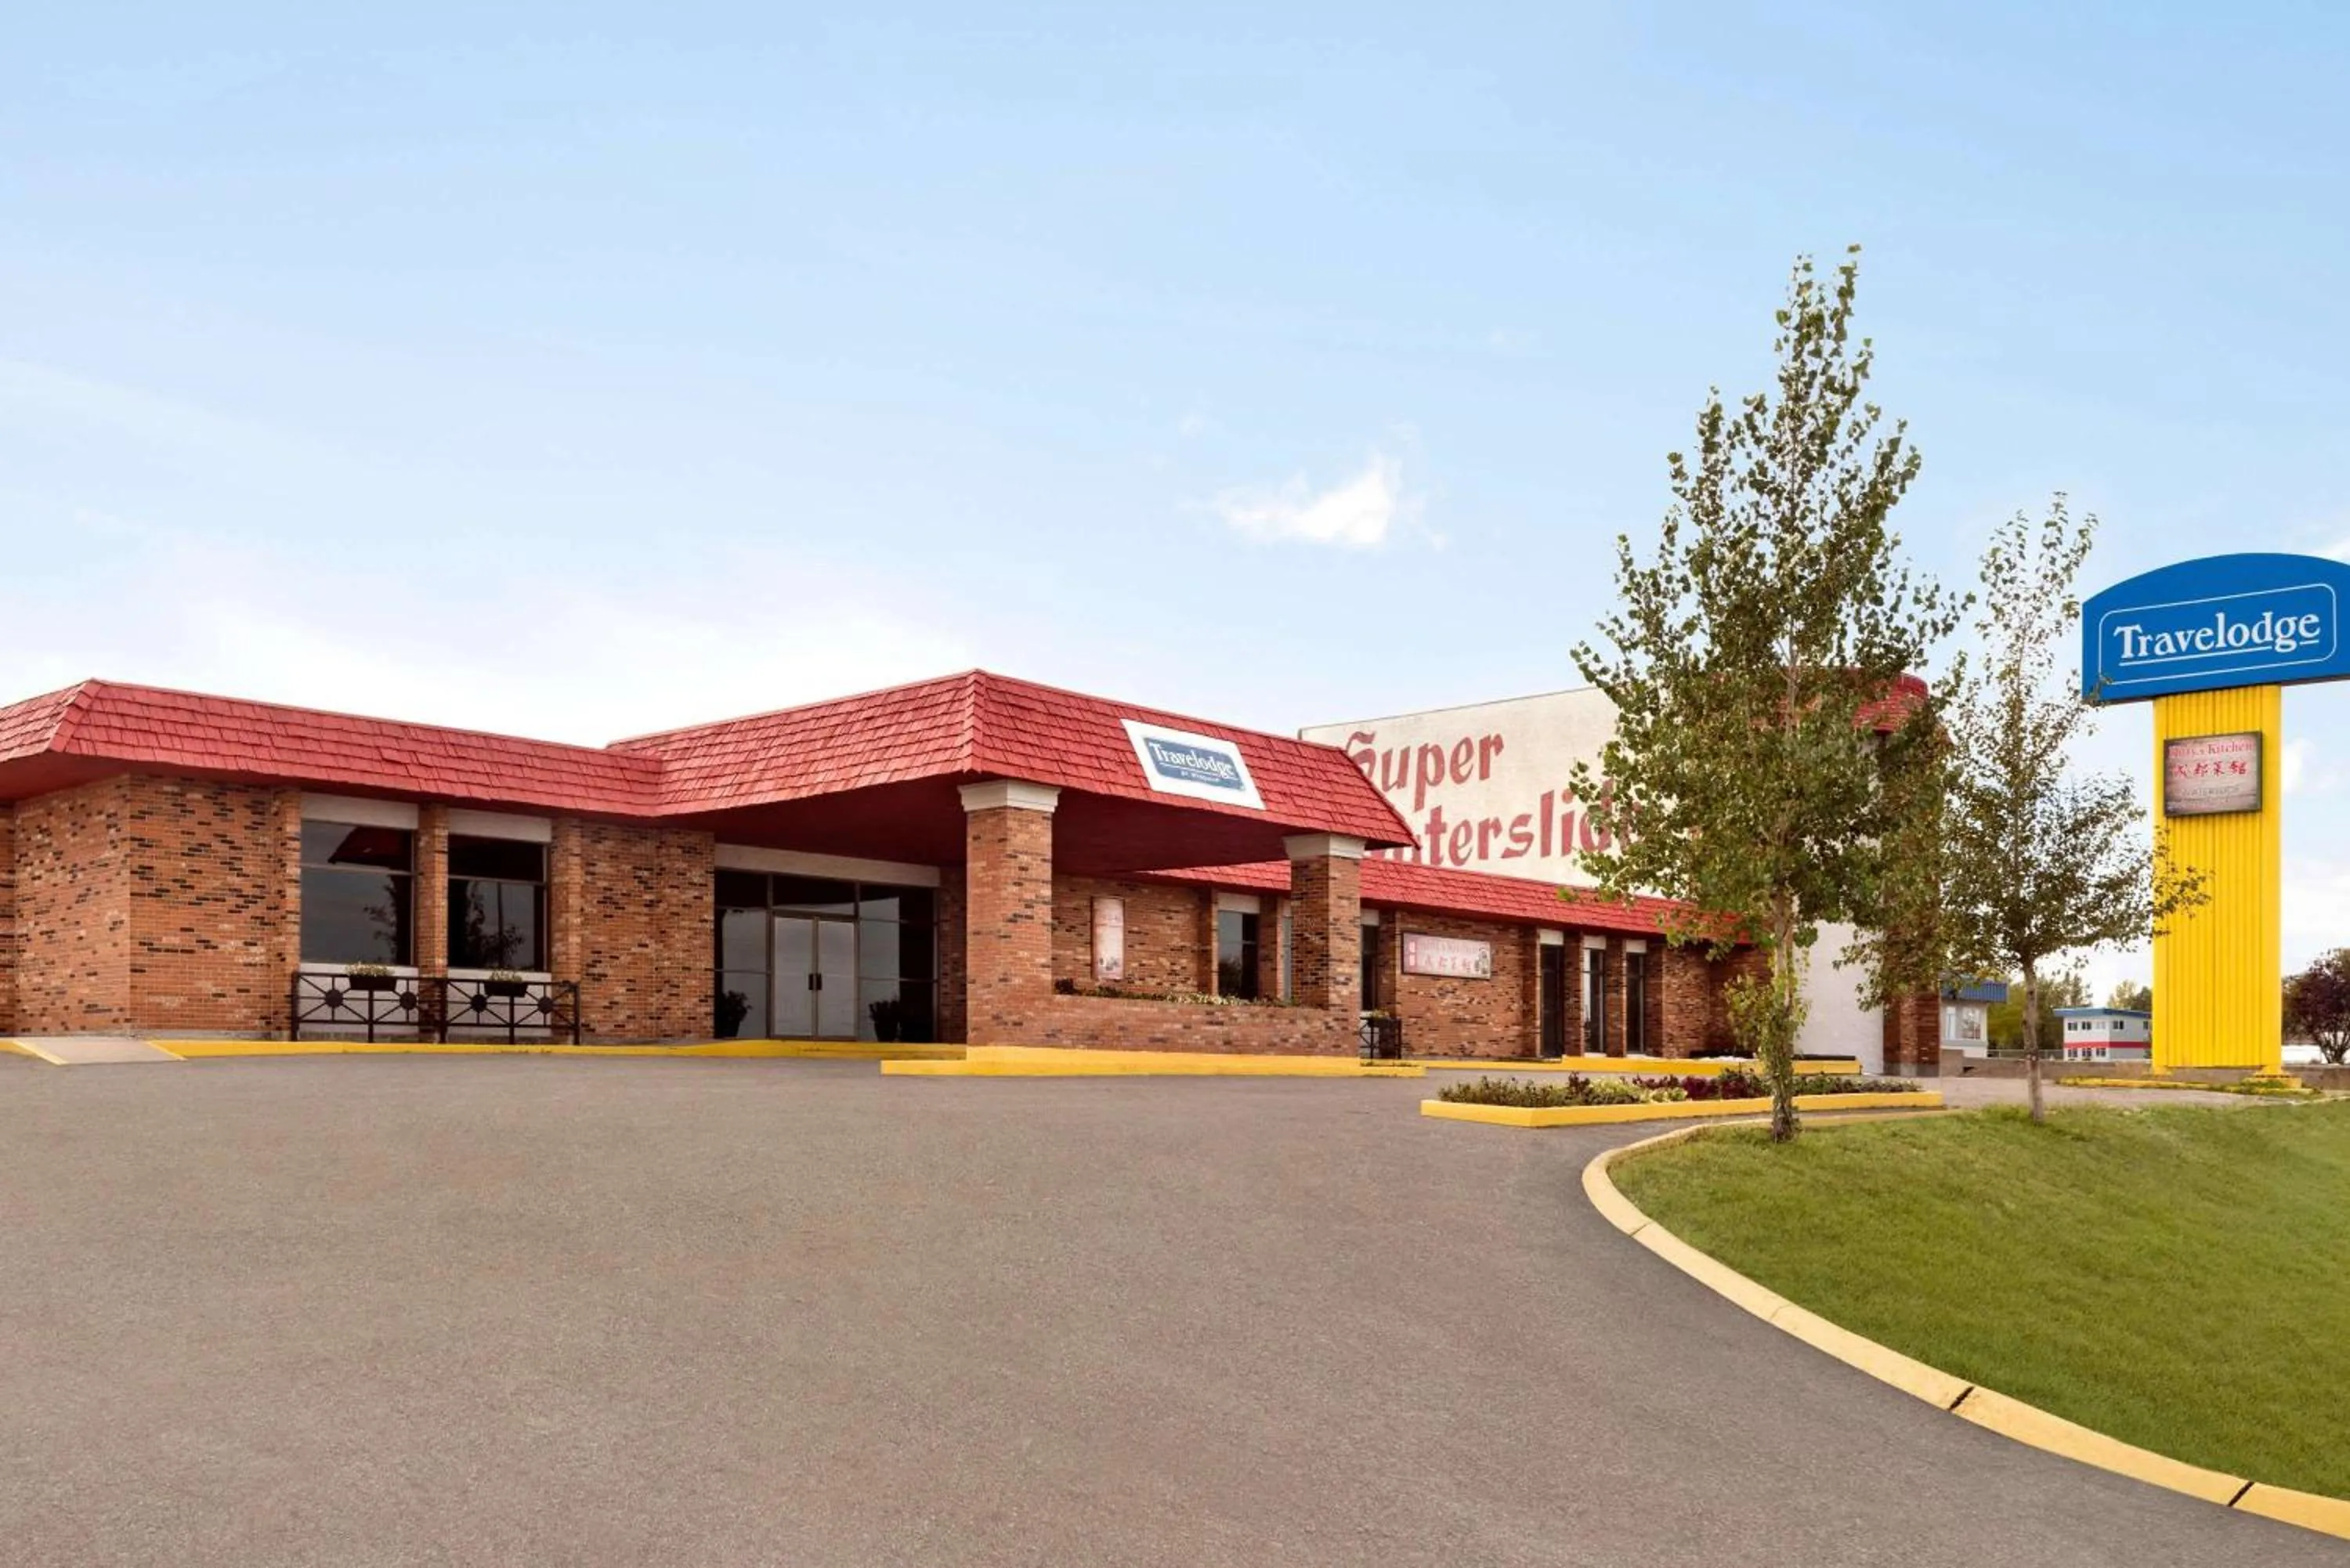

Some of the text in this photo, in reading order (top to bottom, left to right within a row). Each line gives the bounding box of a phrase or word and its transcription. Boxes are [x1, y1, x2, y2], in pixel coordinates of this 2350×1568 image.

[2113, 611, 2321, 659] Travelodge
[1148, 742, 1235, 779] Travelodge
[1345, 730, 1505, 812] Super
[1369, 778, 1643, 867] terslid
